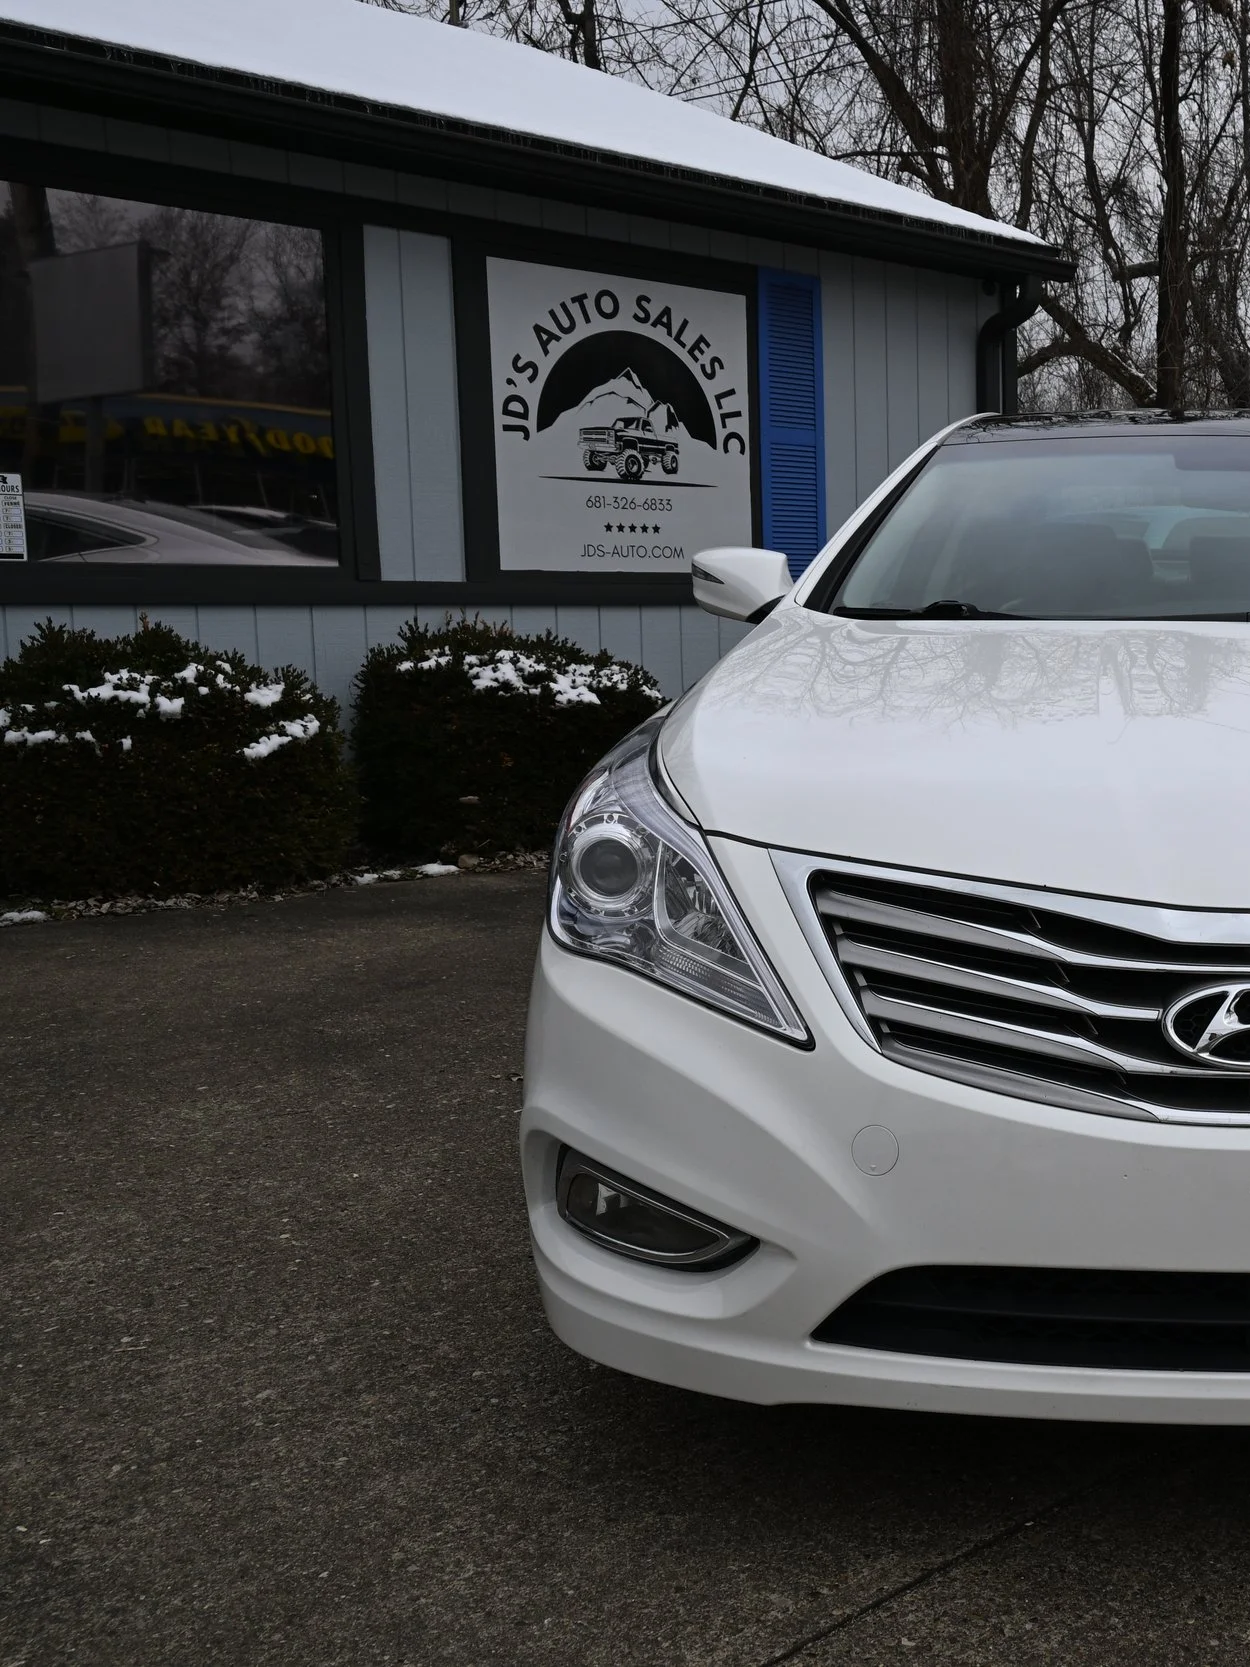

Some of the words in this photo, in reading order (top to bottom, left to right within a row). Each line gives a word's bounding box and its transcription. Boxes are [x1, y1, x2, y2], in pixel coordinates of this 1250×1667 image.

[502, 353, 538, 442] JD'S
[533, 289, 620, 357] AUTO
[632, 294, 725, 381] SALES
[714, 388, 746, 456] LLC
[0, 485, 19, 493] OURS
[586, 495, 673, 512] 681-326-6833
[580, 543, 685, 560] JDS-AUTO.COM
